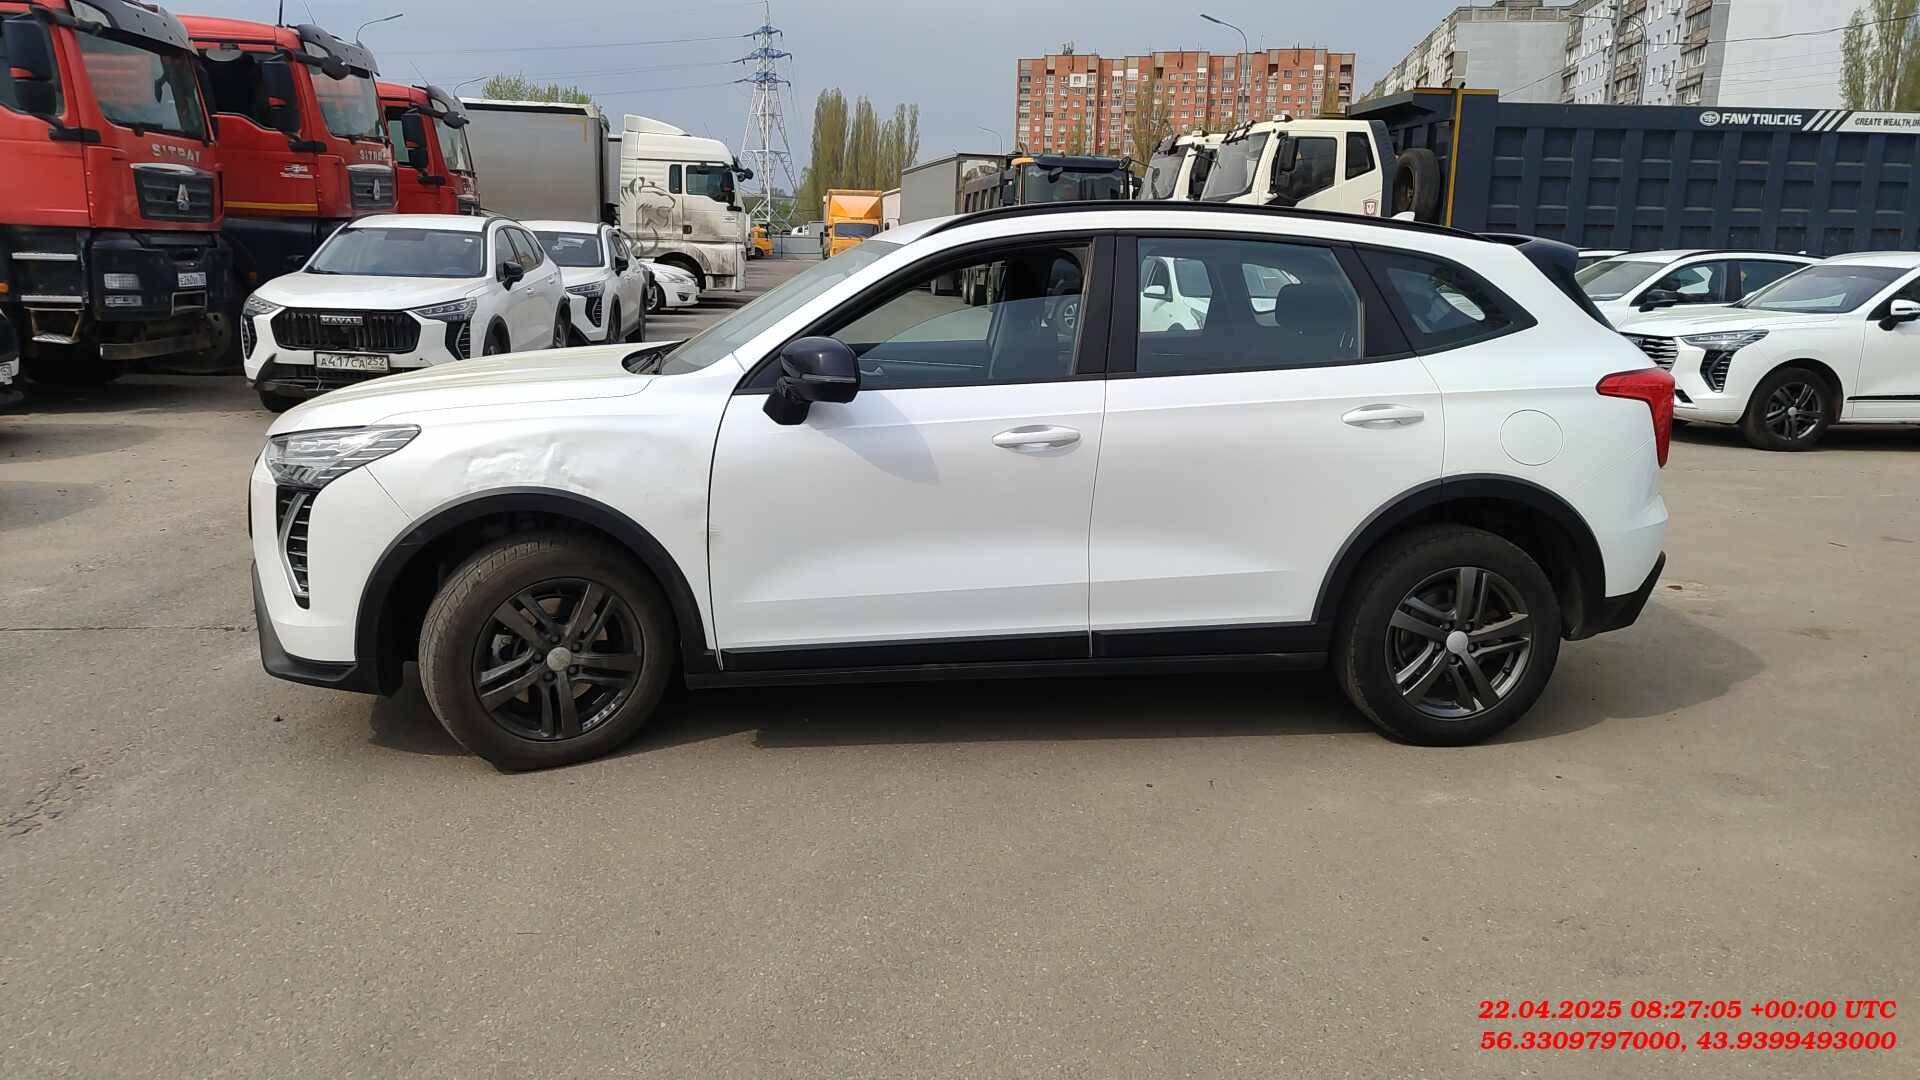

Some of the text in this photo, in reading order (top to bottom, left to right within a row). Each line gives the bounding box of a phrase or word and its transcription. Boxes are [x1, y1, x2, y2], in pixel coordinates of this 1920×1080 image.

[1721, 112, 1802, 126] FAW TRUCKS
[1854, 117, 1882, 127] CREATE
[321, 316, 362, 325] HAVAL
